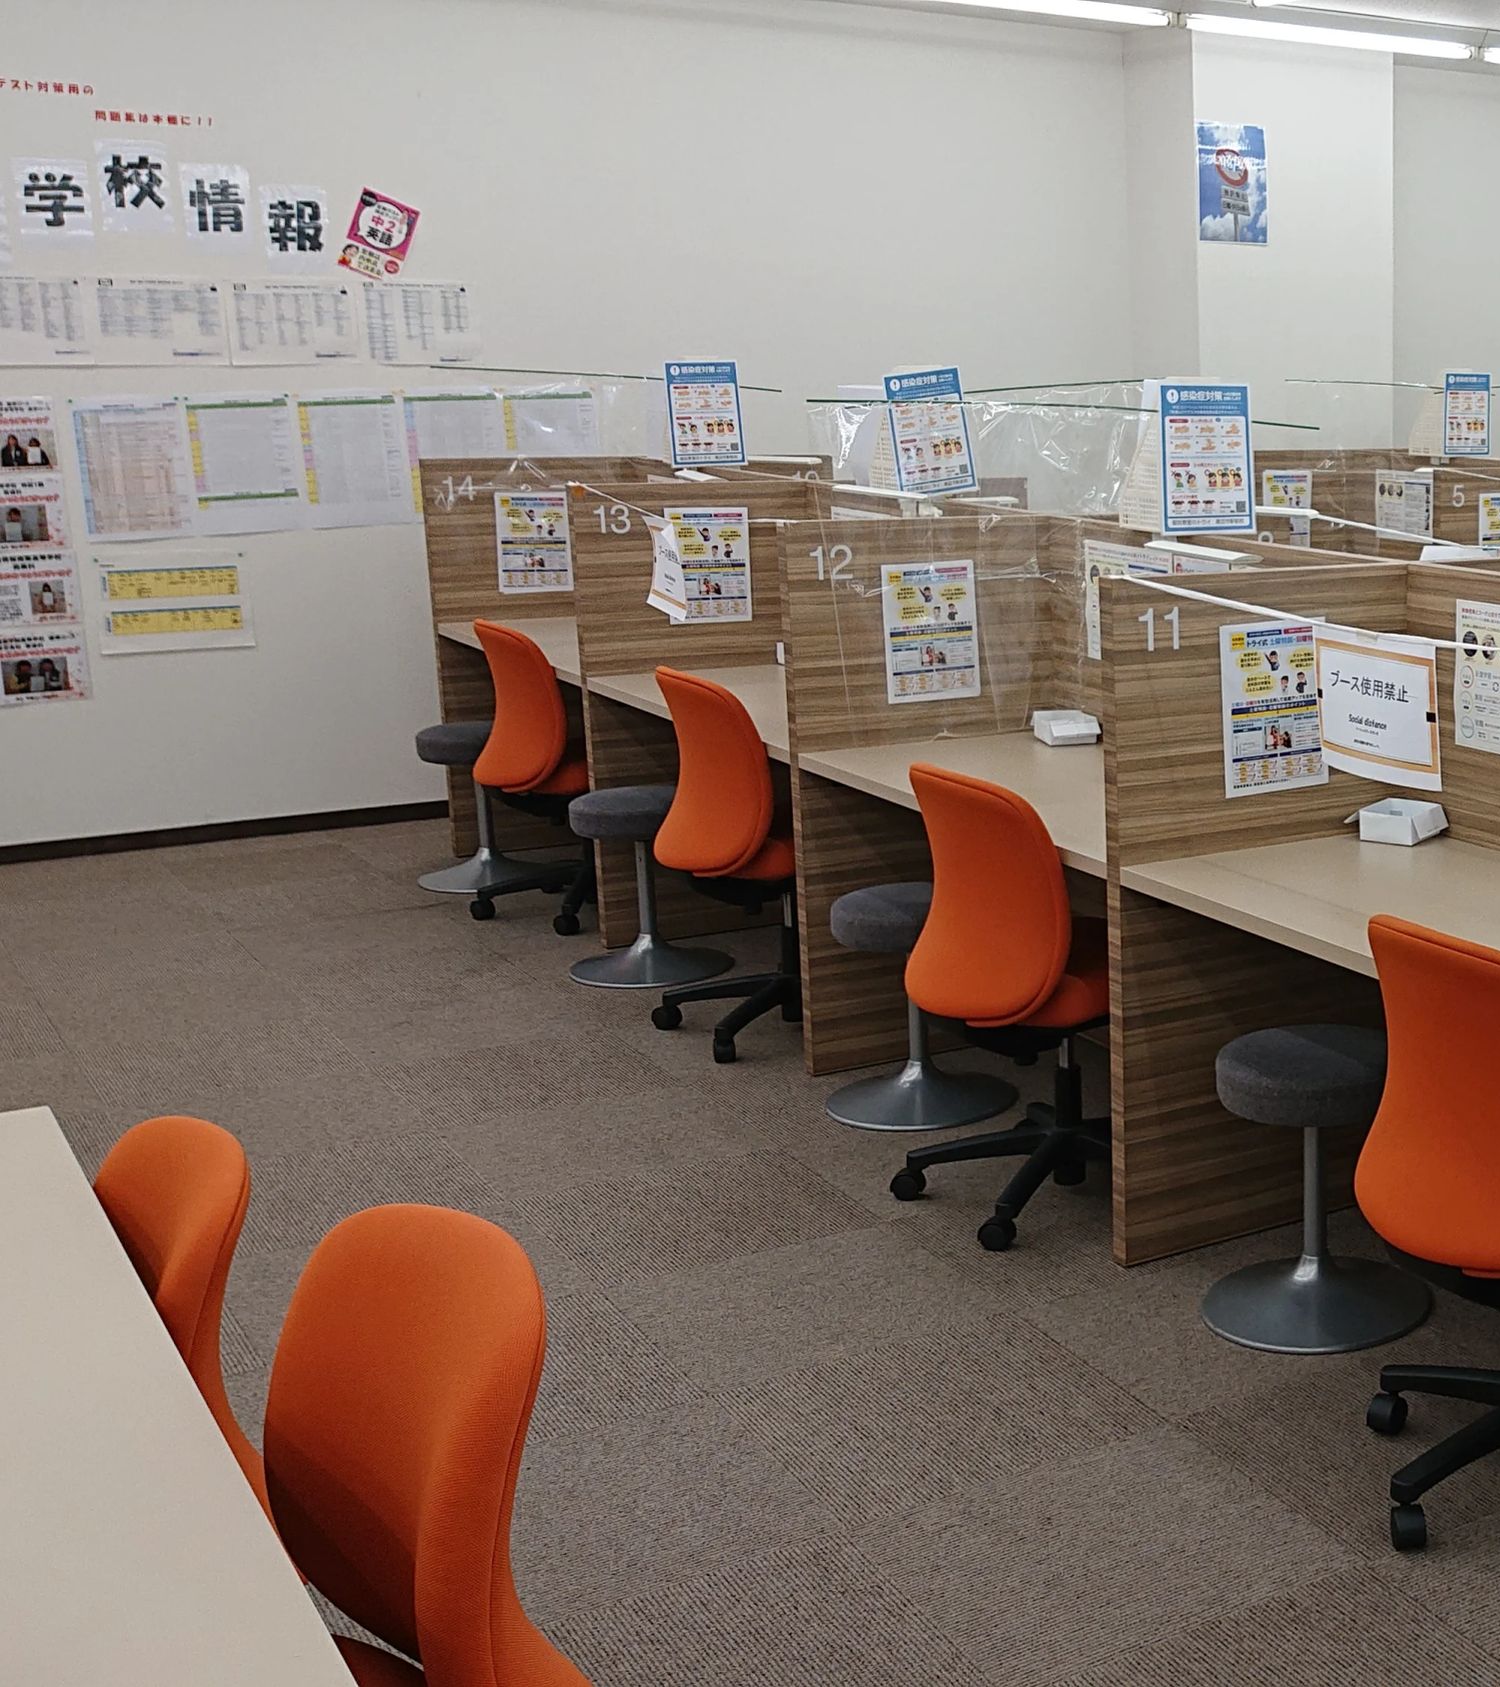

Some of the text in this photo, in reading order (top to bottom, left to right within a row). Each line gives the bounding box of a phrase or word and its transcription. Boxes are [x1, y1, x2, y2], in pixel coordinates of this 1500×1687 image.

[24, 154, 325, 252] 学校情報
[443, 475, 474, 503] 14
[1453, 485, 1466, 508] 5
[593, 505, 632, 535] 13
[810, 544, 853, 581] 12
[1138, 606, 1180, 652] 11
[1330, 669, 1410, 704] ブース使用禁止
